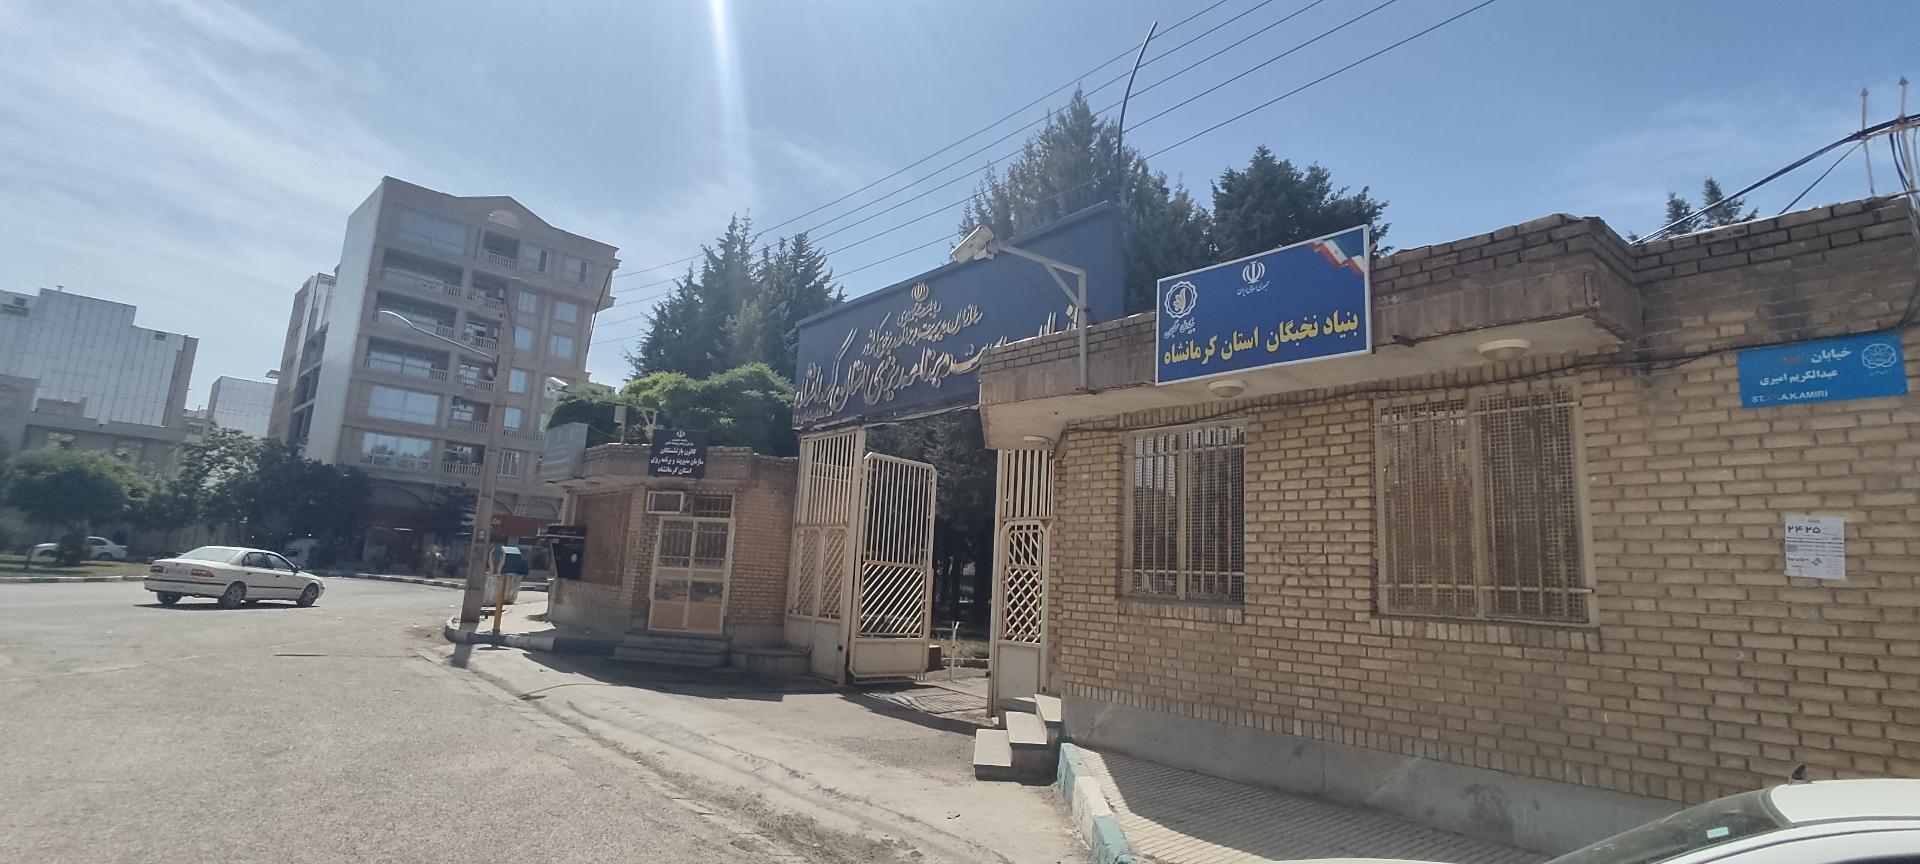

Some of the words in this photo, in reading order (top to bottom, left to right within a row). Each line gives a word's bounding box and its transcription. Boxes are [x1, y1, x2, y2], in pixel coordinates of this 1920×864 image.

[1322, 310, 1359, 339] بنیاد
[1265, 314, 1319, 352] نخبگان
[1163, 334, 1218, 366] کرمانشاه
[1220, 326, 1260, 361] استان
[1811, 346, 1853, 364] خیابان
[1759, 372, 1788, 387] امیری
[1789, 369, 1839, 384] عبدالکریم
[690, 458, 704, 466] سازمان
[657, 466, 679, 475] کرمانشاه
[678, 467, 693, 475] استان
